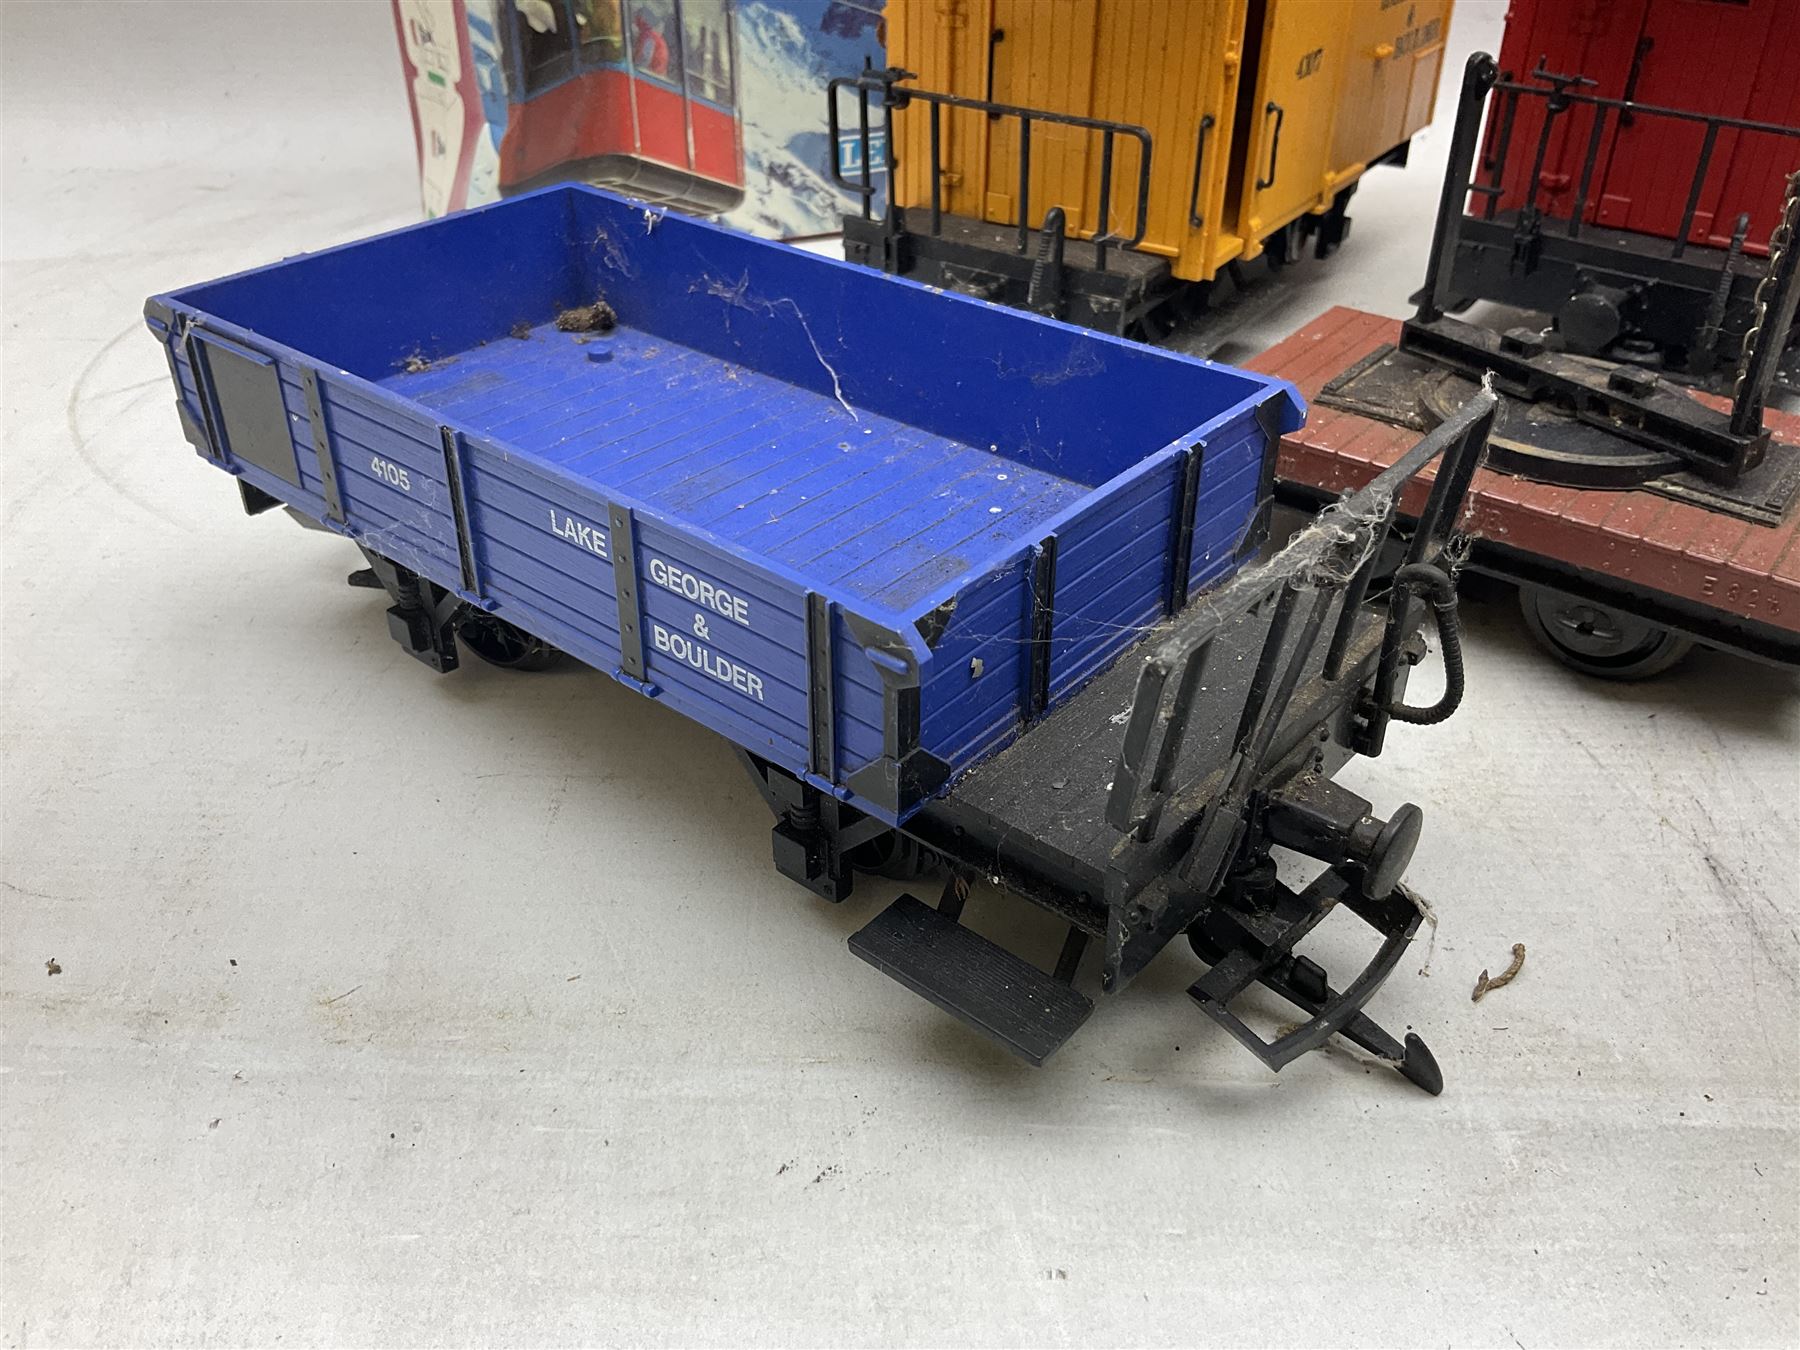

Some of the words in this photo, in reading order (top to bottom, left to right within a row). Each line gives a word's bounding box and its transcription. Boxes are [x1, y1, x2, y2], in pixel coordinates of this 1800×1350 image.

[371, 456, 411, 491] 4105
[550, 510, 608, 558] LAKE
[650, 558, 750, 626] GEORGE
[693, 613, 711, 641] &
[653, 624, 764, 701] BOULDER
